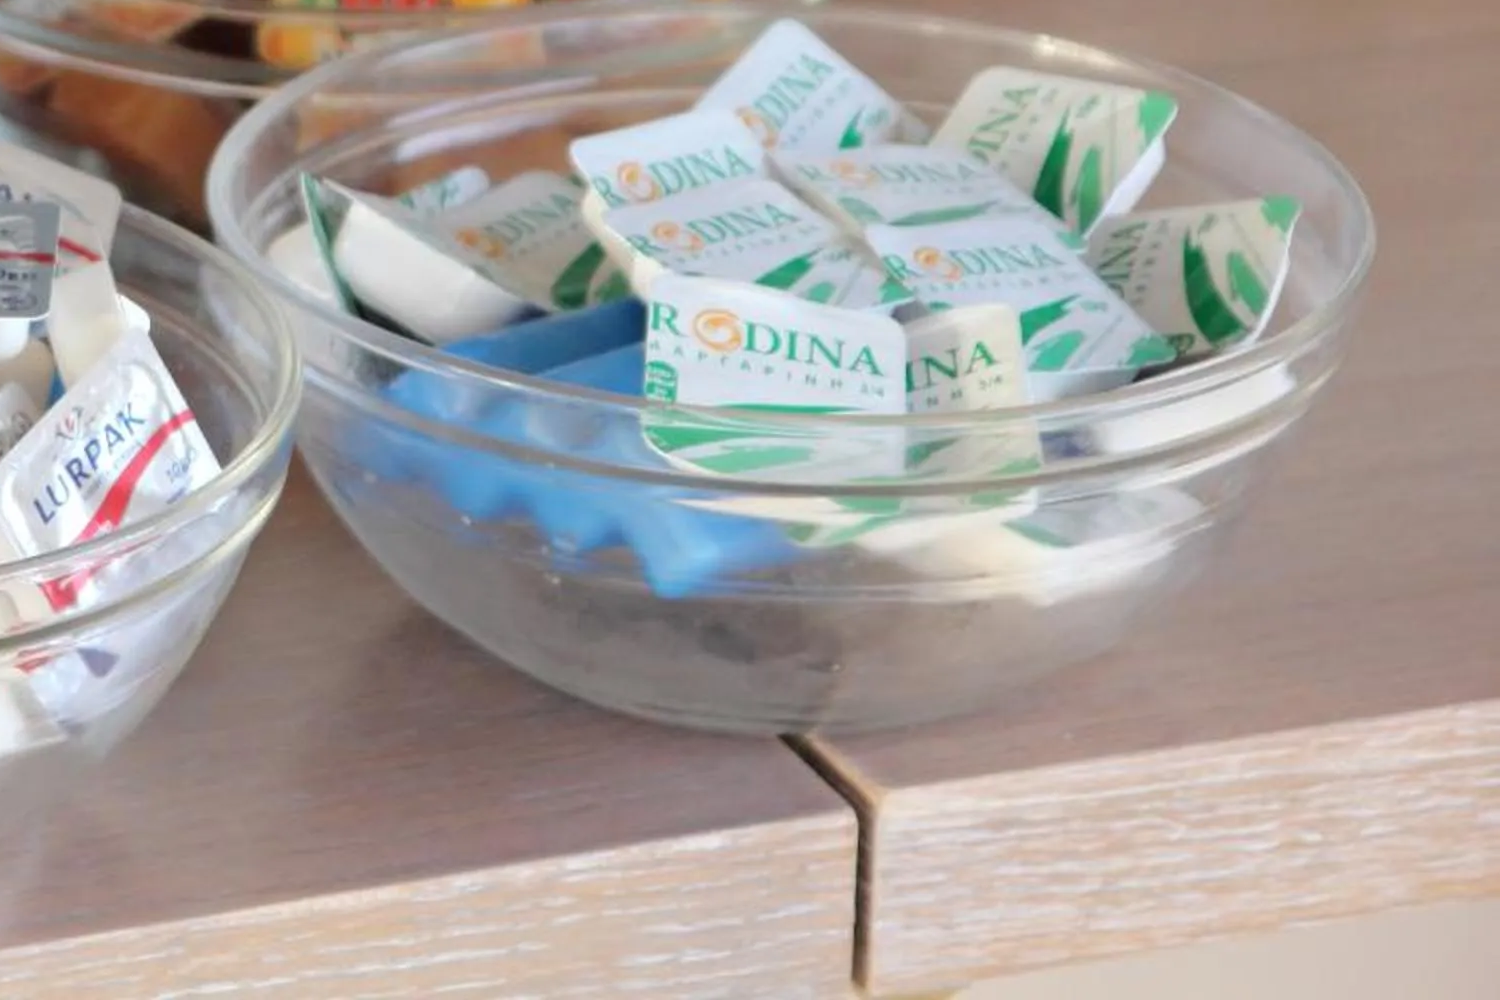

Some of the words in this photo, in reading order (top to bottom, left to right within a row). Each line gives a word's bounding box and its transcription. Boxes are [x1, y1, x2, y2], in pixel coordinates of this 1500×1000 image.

[591, 144, 756, 206] RODINA
[626, 202, 802, 254] RODINA
[883, 245, 1063, 284] RODINA
[649, 301, 886, 378] RODINA
[32, 402, 148, 526] LURPAK
